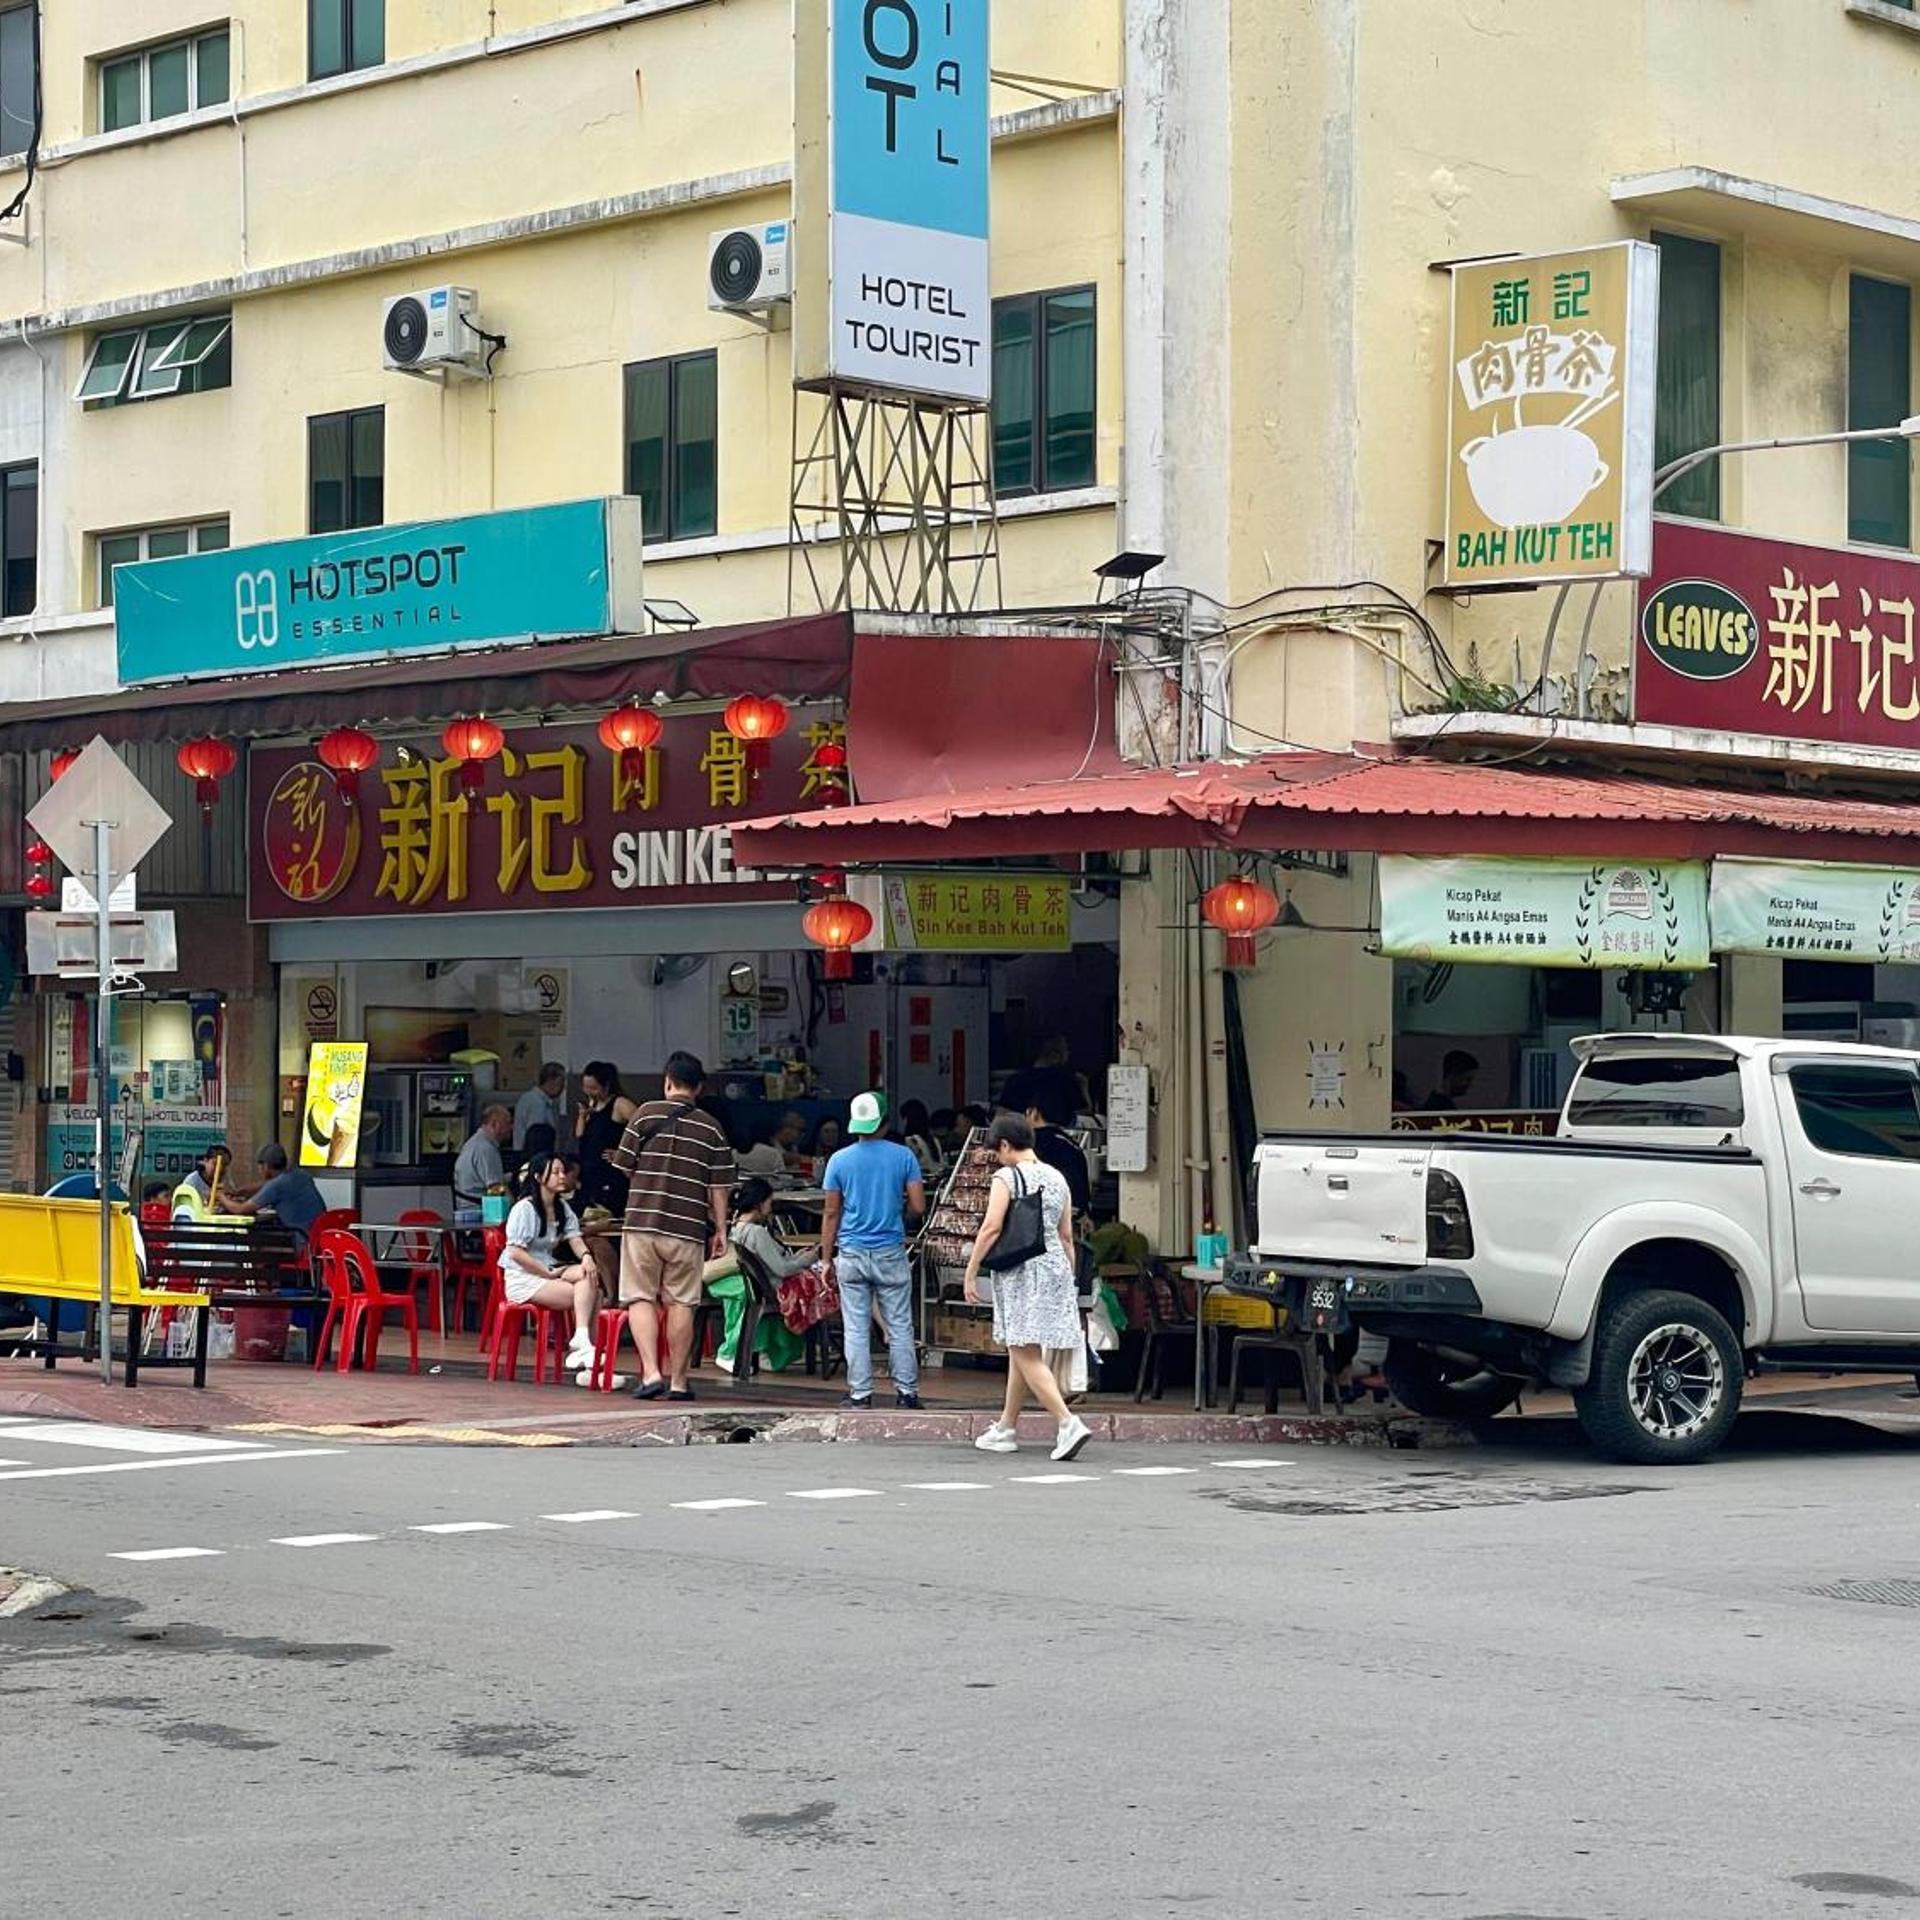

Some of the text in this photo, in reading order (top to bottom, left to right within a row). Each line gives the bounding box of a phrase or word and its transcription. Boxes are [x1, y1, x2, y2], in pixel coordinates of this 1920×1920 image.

[861, 273, 966, 318] HOTEL
[1492, 270, 1591, 328] 新記
[845, 319, 981, 367] TOURIST
[1469, 326, 1606, 400] 肉骨茶
[1456, 520, 1613, 568] BAH KUT TEH
[288, 545, 467, 604] HOTSPOT
[292, 604, 462, 640] ESSENTIAL
[1654, 601, 1750, 656] LEAVES
[1761, 566, 1920, 722] 新记
[374, 744, 594, 906] 新记
[917, 882, 1065, 916] 新记肉骨茶
[1446, 888, 1502, 903] Kicap Pekat
[1447, 909, 1475, 922] Manis
[1490, 910, 1521, 926] Angsa
[1522, 910, 1548, 923] Emas
[917, 918, 1066, 936] Sin Kee Bah Kut Teh
[1834, 920, 1856, 931] Emas
[152, 1110, 223, 1124] HOTEL TOURIST
